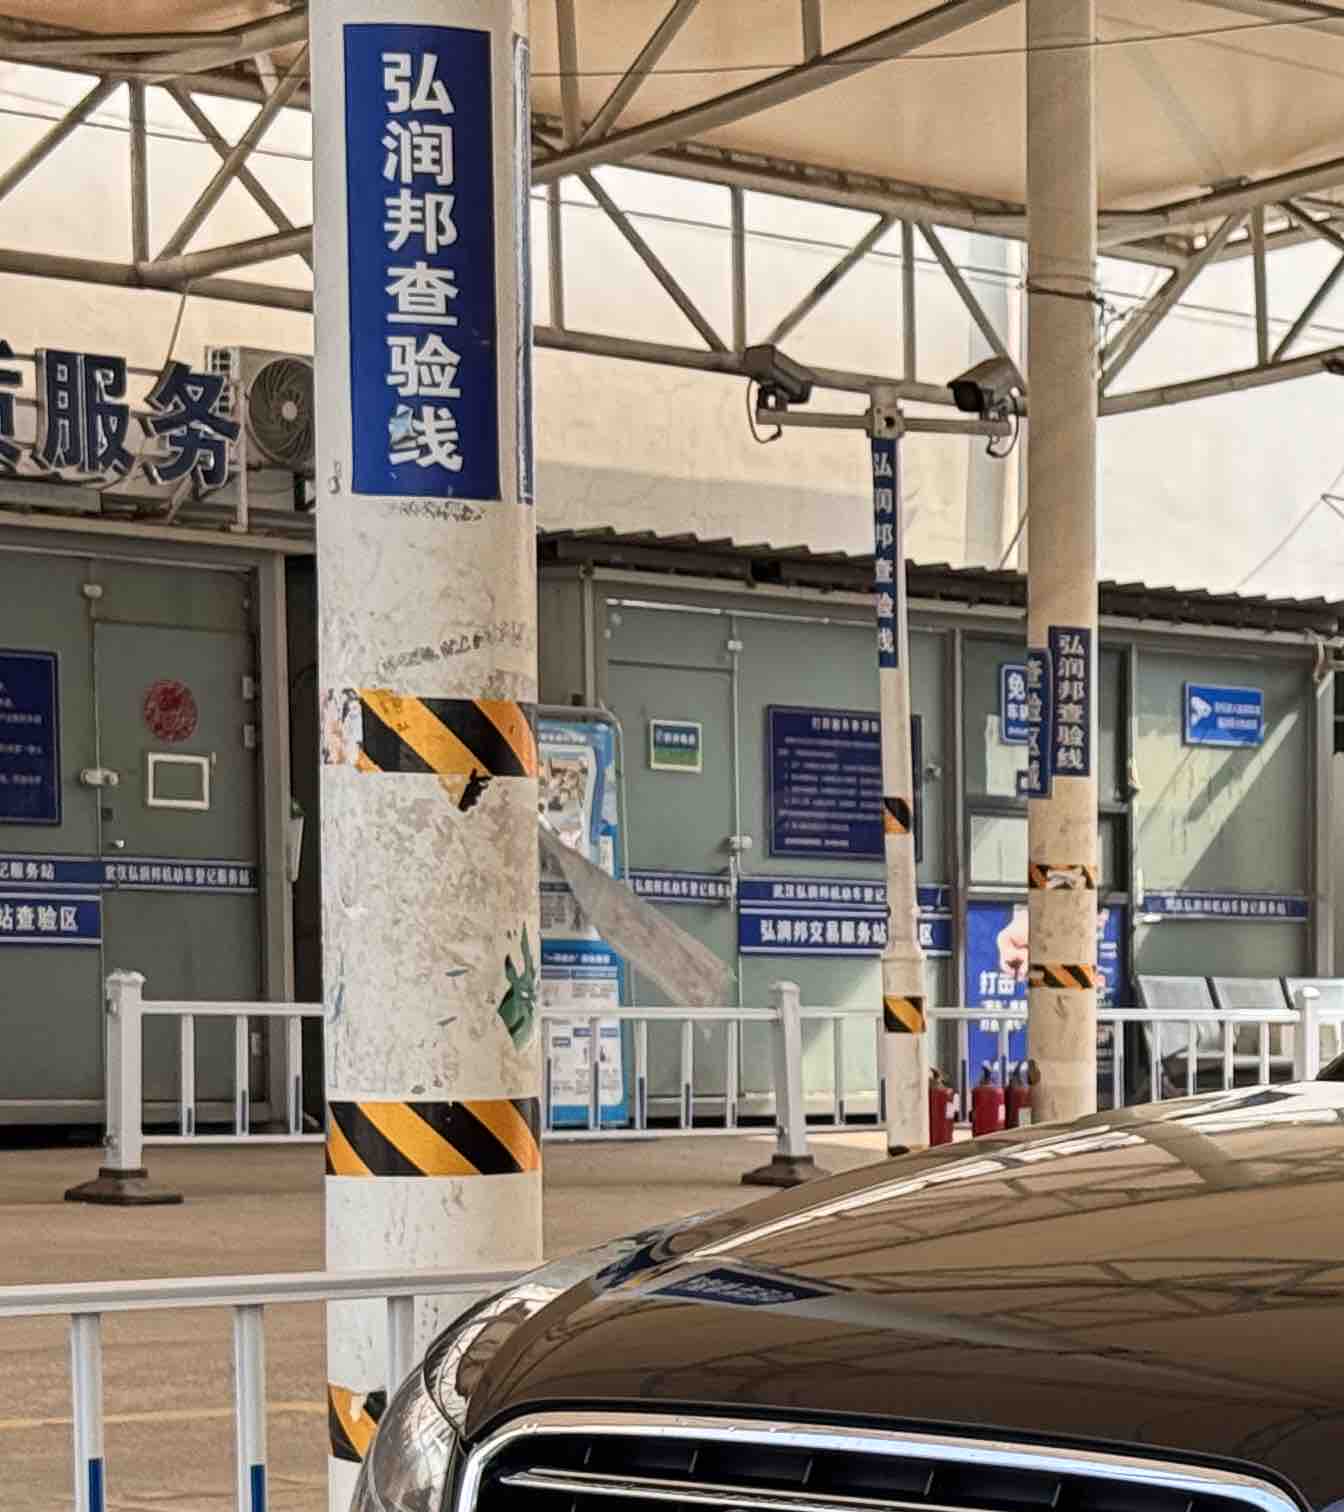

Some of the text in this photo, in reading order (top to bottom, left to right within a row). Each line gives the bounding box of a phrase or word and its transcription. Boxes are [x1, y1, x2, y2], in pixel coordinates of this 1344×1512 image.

[381, 52, 464, 474] 弘润邦查验线
[1055, 633, 1086, 770] 弘润邦查验线
